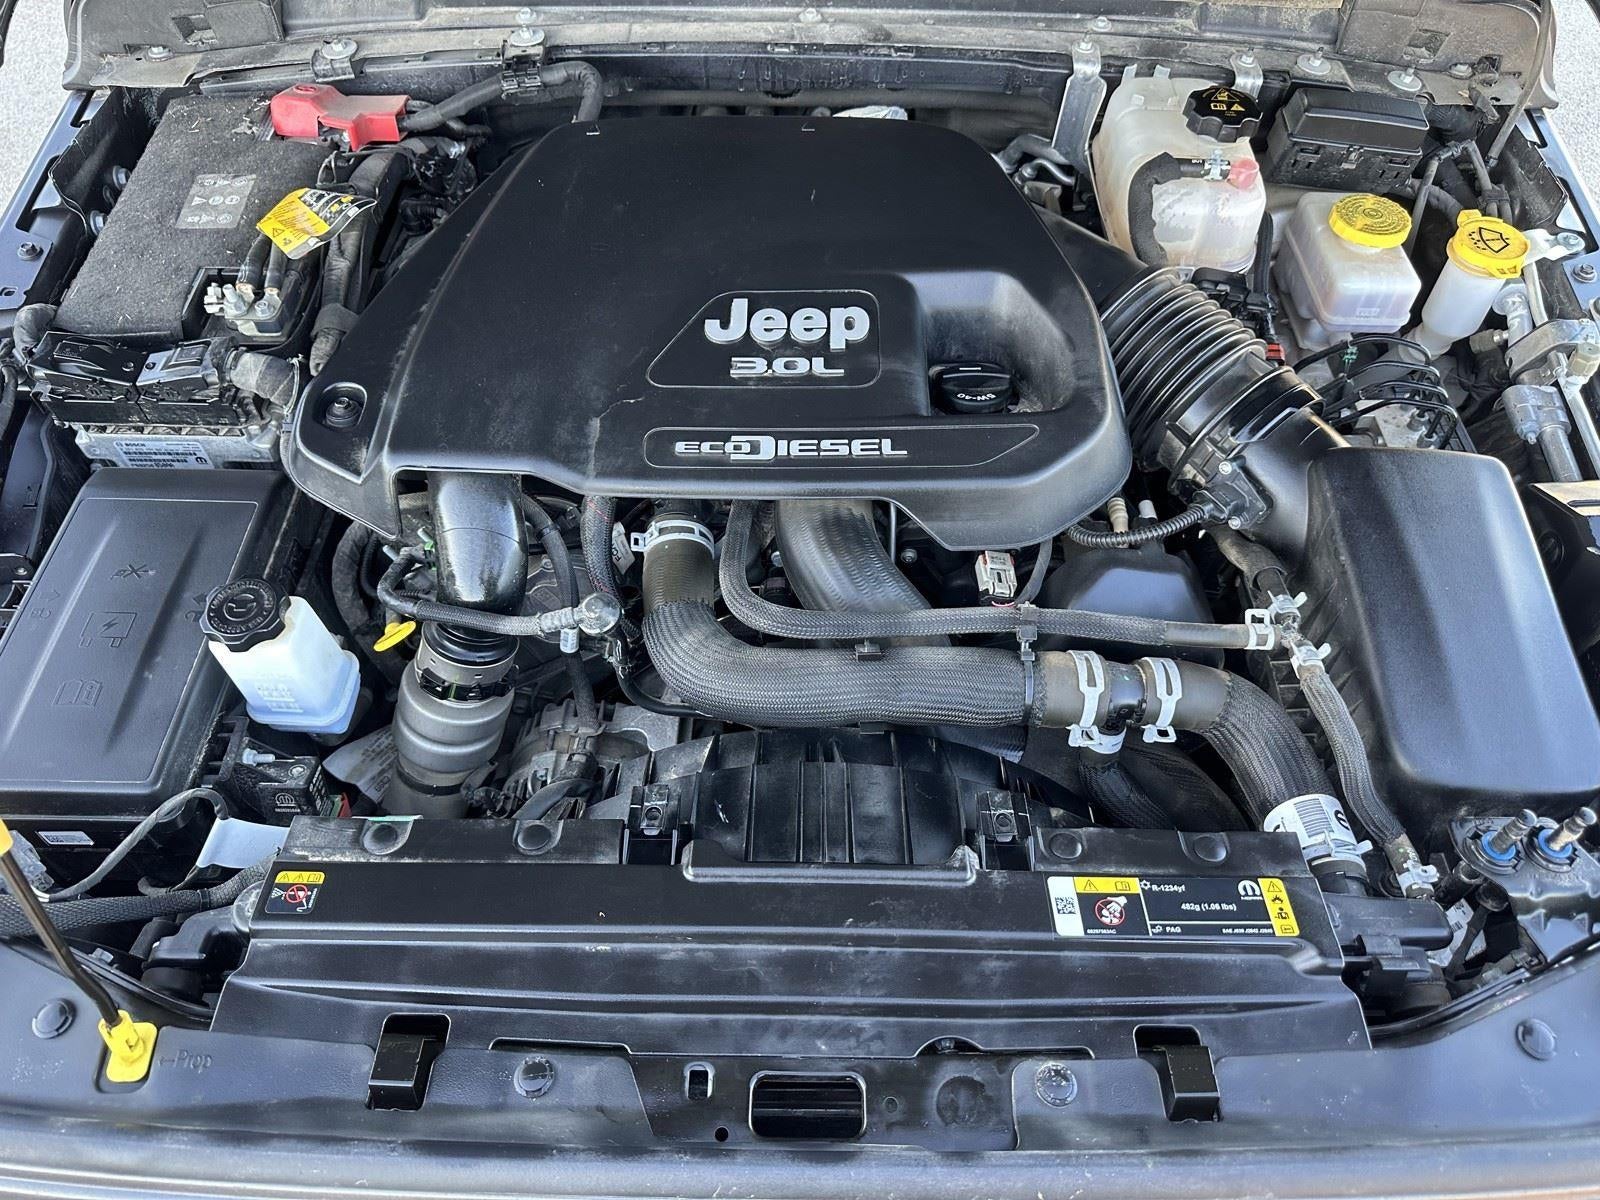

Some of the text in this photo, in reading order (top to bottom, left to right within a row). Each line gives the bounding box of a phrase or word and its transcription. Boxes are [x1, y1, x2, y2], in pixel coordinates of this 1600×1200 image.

[704, 298, 870, 351] Jeep
[730, 357, 845, 378] 3.0L
[957, 393, 996, 401] 5W-40
[1151, 884, 1186, 893] R-1234yf
[1181, 903, 1201, 912] 482g
[1221, 903, 1237, 911] lbs)
[173, 1050, 212, 1074] Prop
